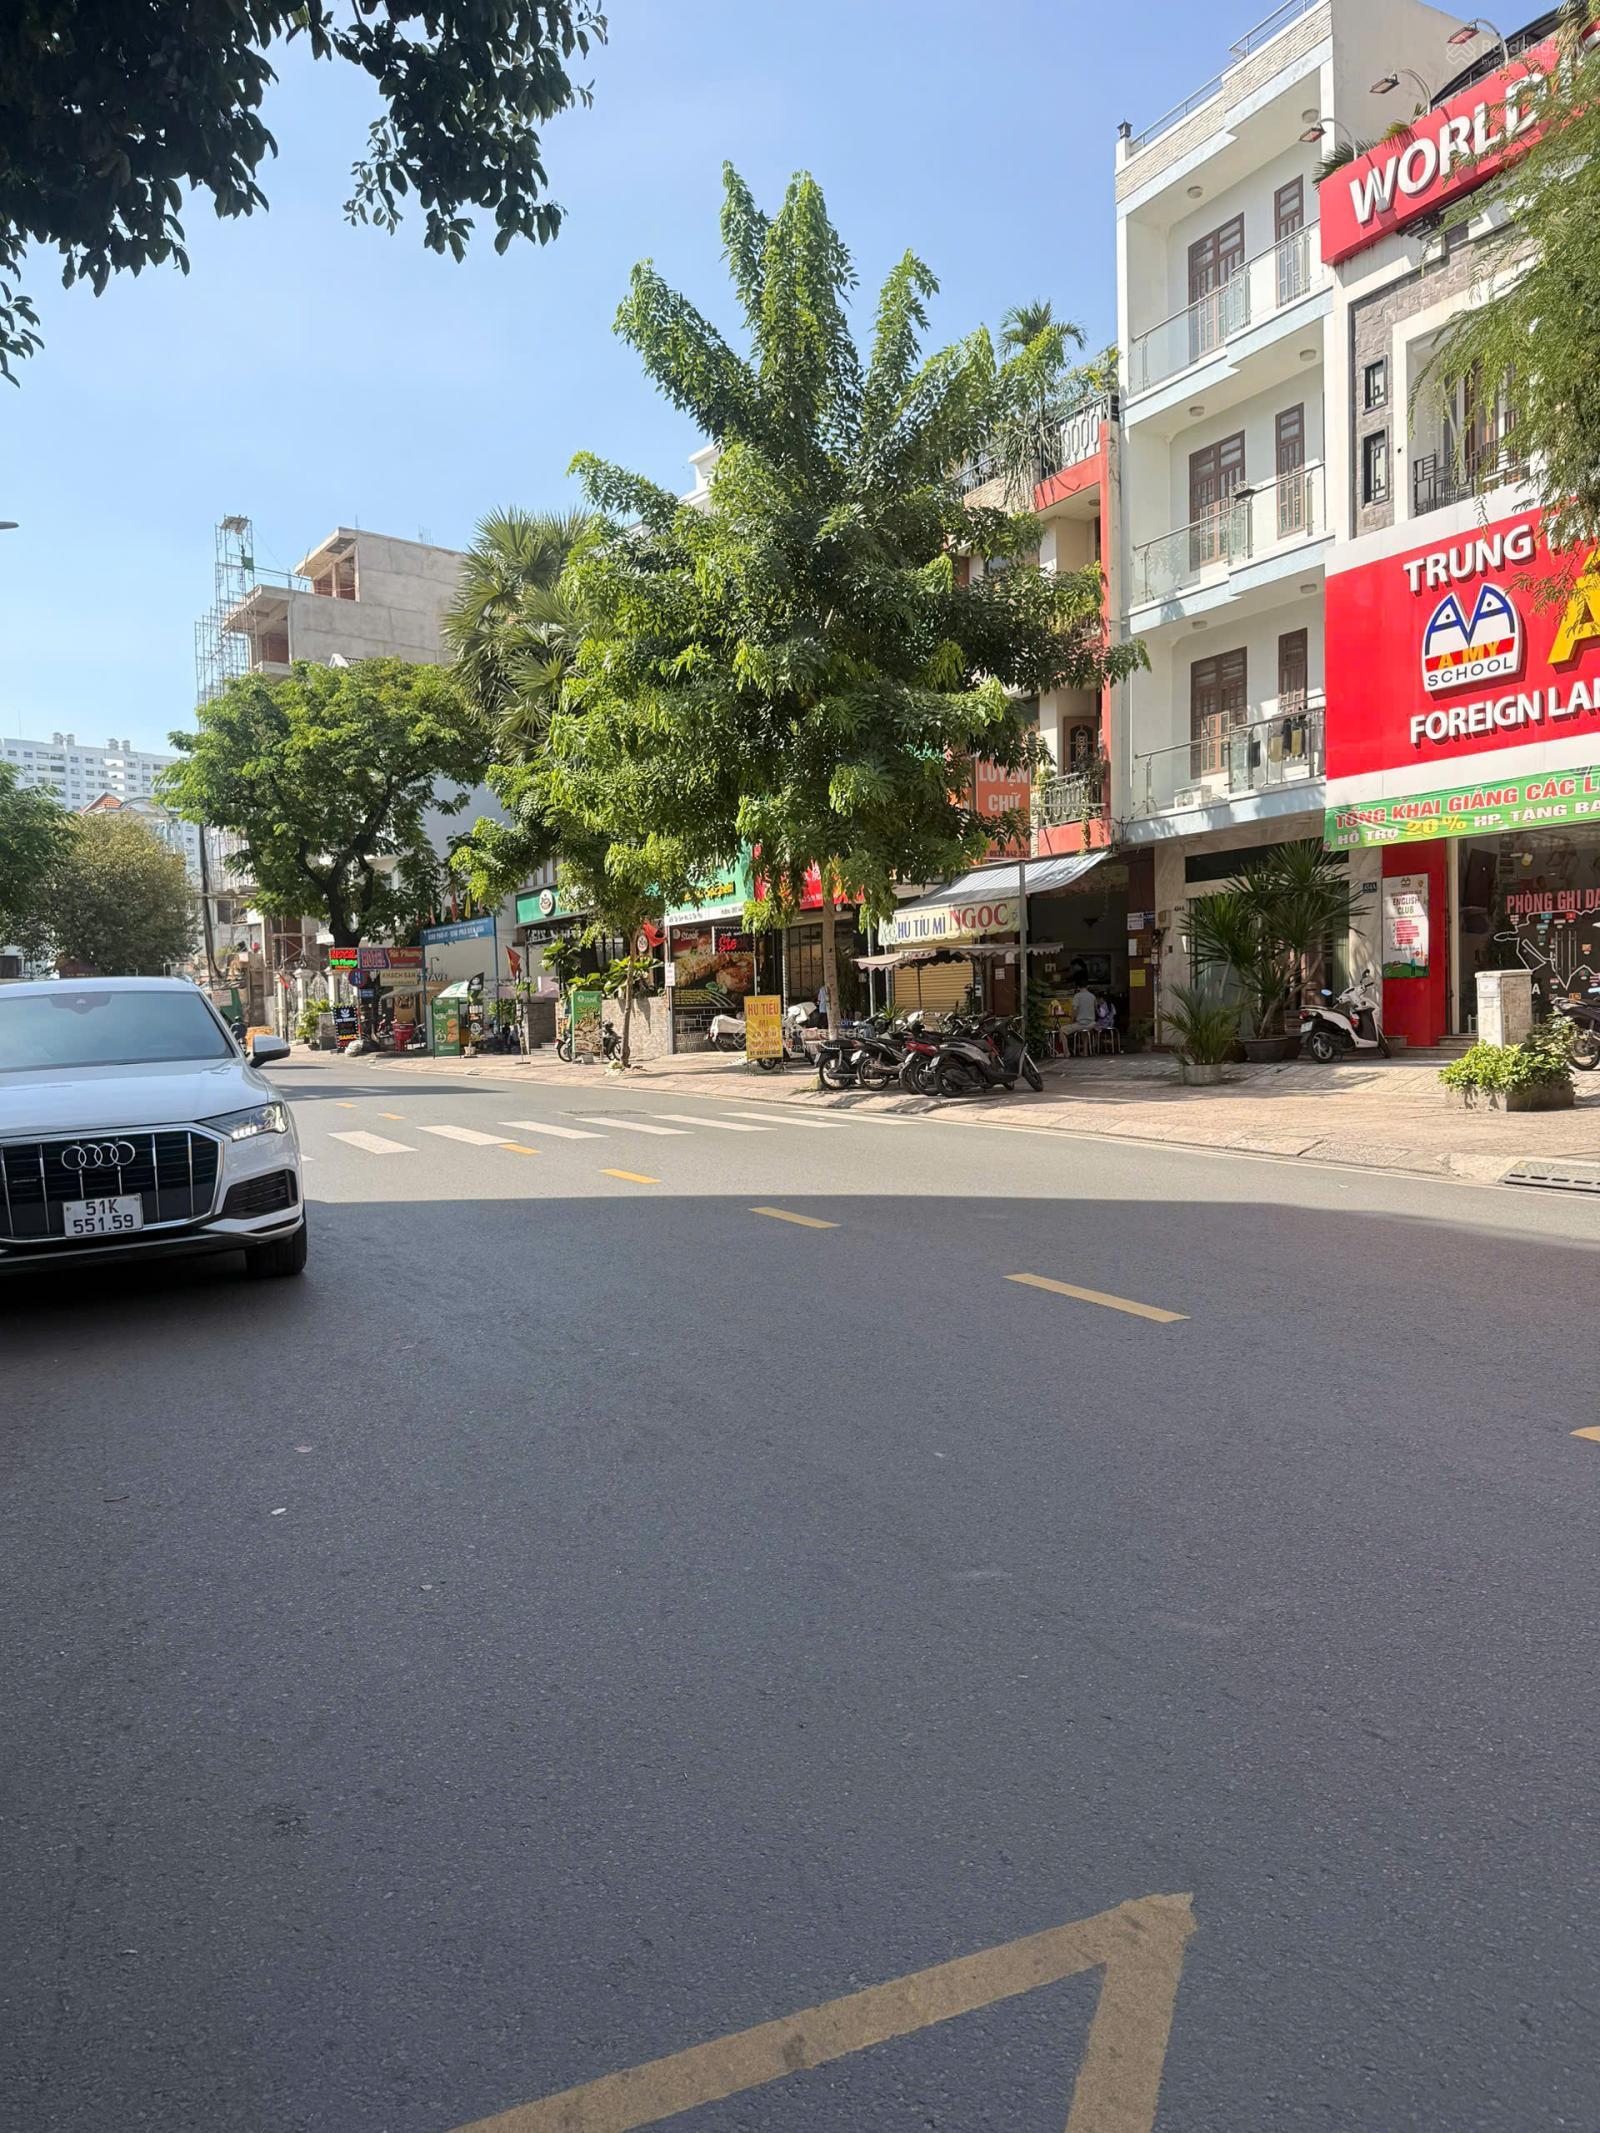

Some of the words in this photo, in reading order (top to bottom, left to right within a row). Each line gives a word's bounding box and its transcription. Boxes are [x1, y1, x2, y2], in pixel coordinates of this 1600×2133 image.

[1350, 73, 1548, 225] WORLD
[1403, 524, 1532, 592] TRUNG
[1427, 656, 1514, 687] SCHOOL
[1410, 690, 1542, 744] FOREIGN
[1392, 800, 1441, 819] KHAI
[1449, 787, 1518, 812] GIẢNG
[1526, 778, 1575, 800] CÁC
[1397, 905, 1415, 915] CLUB
[1505, 890, 1553, 914] PHÒNG
[1557, 888, 1582, 911] GHI
[949, 903, 1009, 934] NGỌC
[86, 1198, 119, 1216] 51K
[73, 1214, 134, 1234] 551.59
